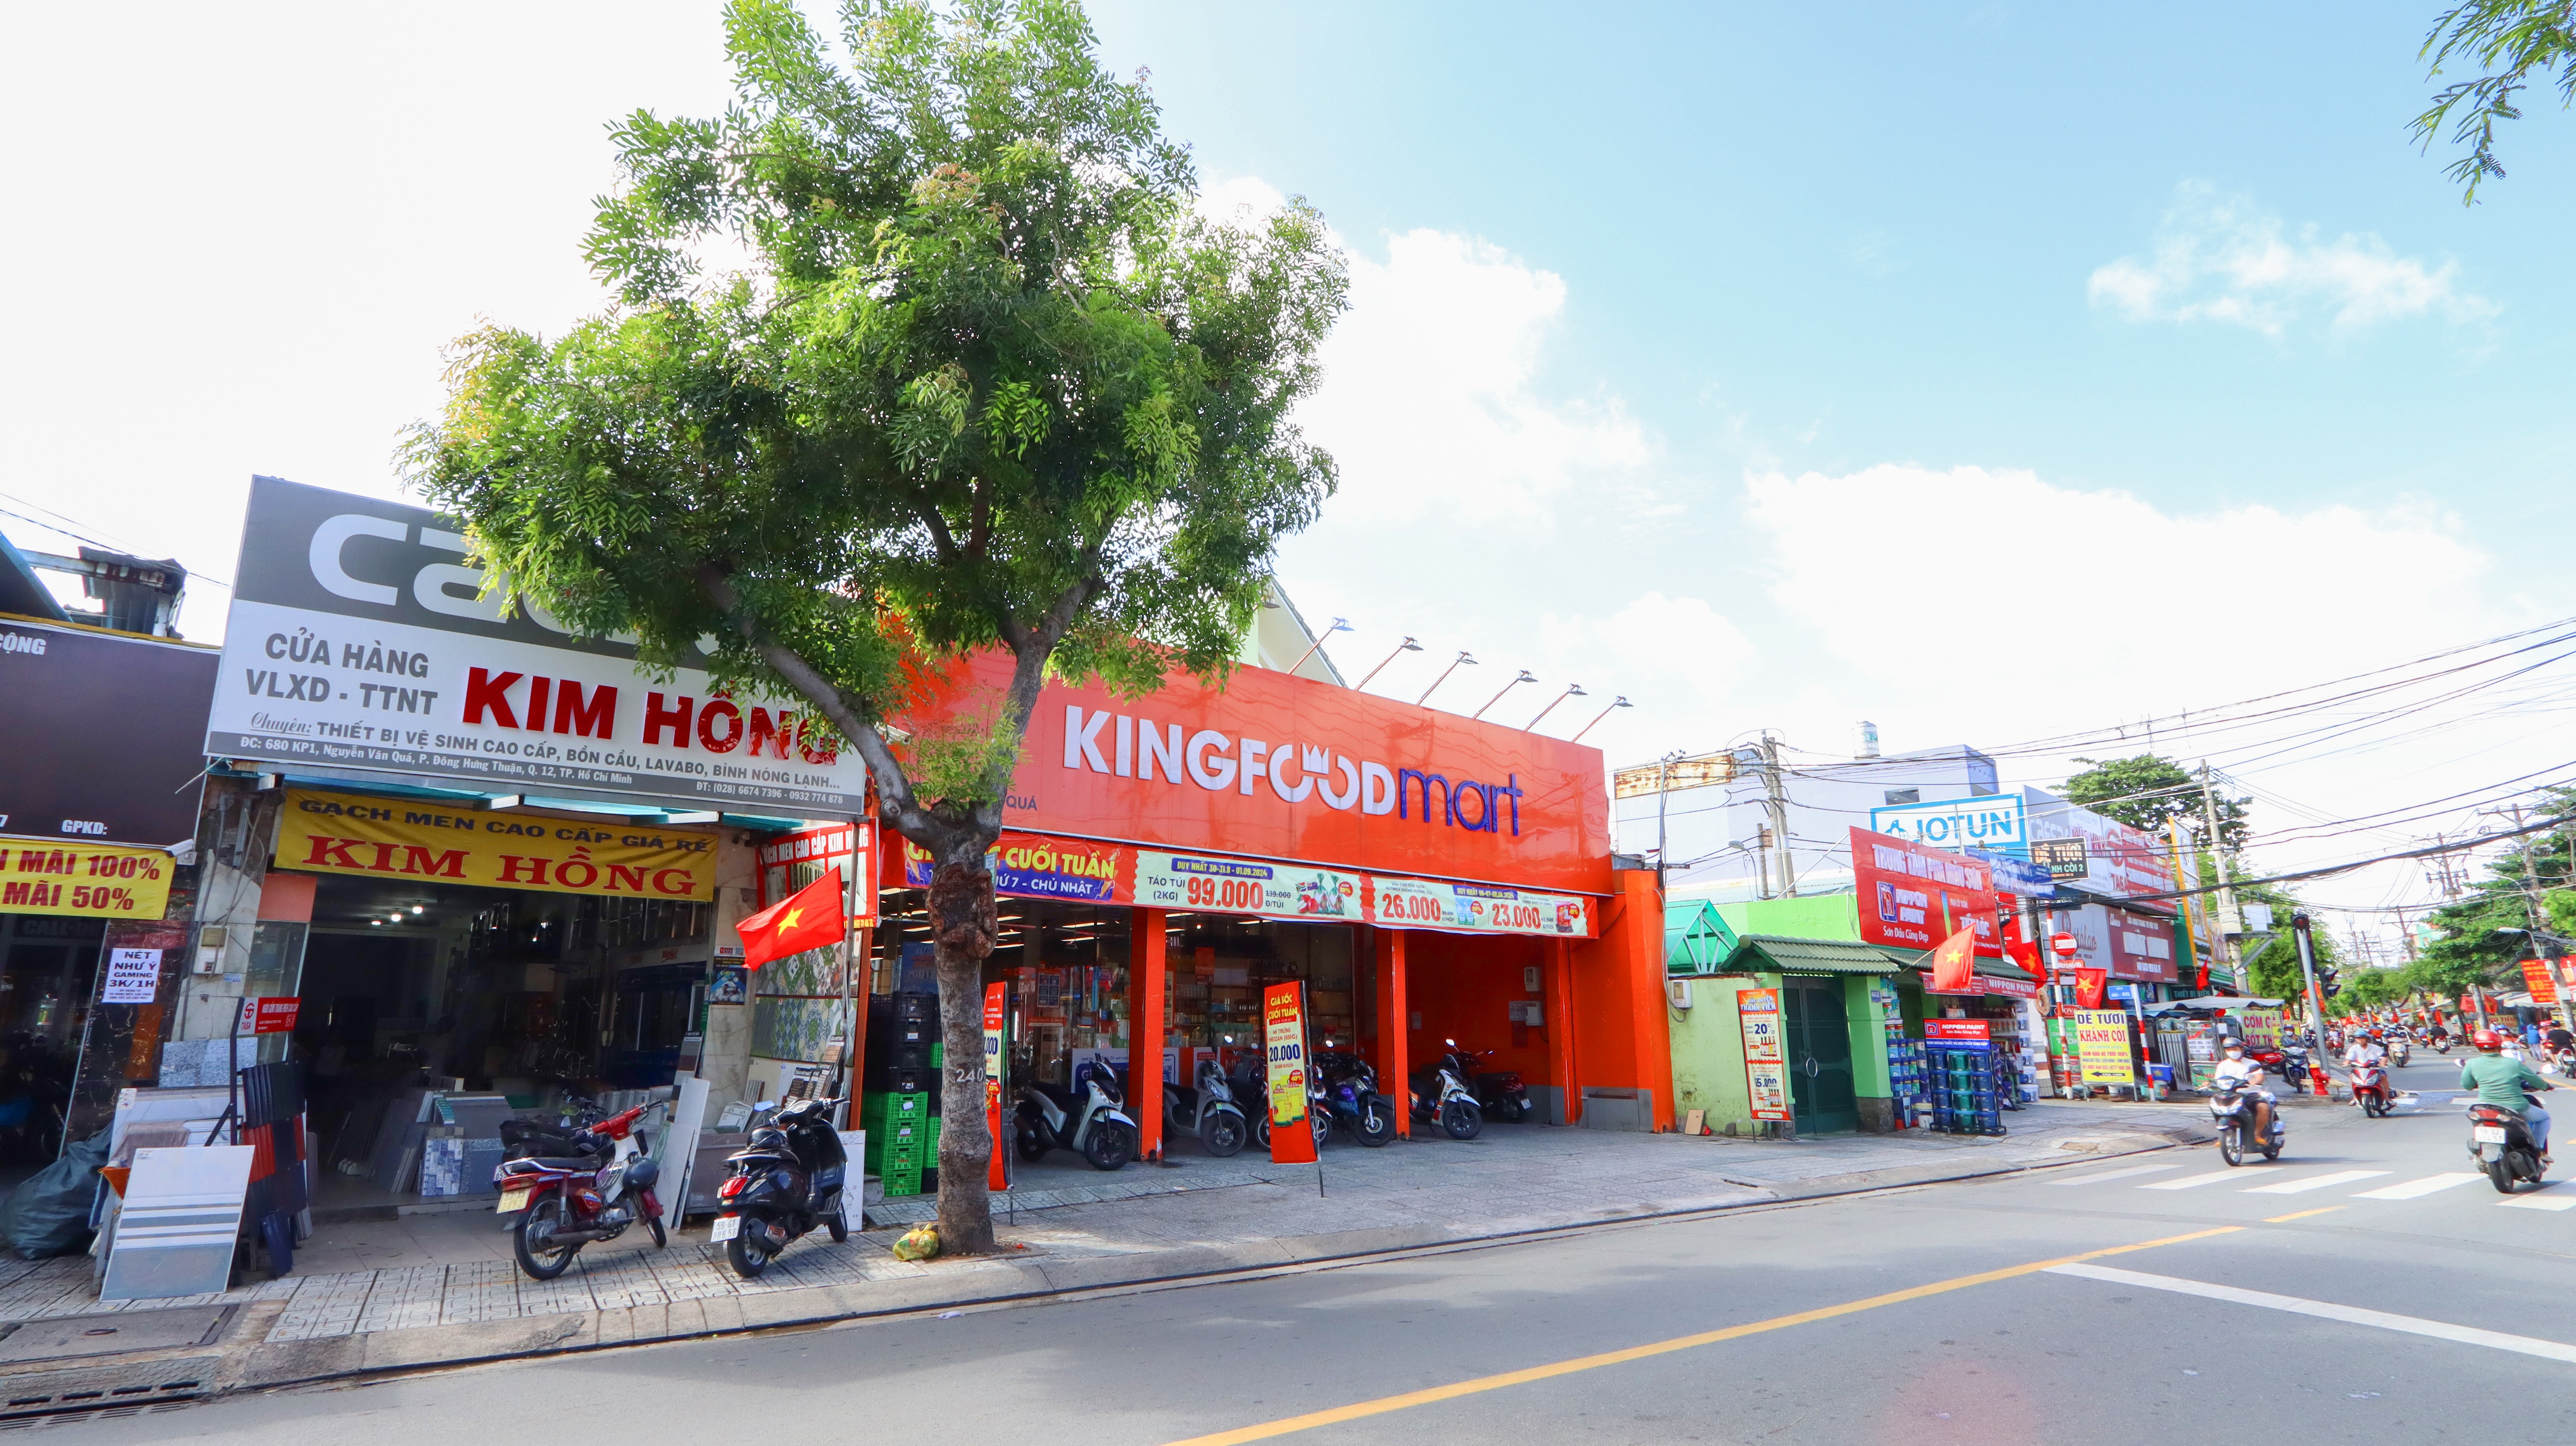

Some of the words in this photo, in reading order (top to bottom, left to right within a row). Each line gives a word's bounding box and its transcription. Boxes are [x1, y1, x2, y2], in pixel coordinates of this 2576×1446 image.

[0, 632, 46, 655] ỘNG
[265, 626, 331, 666] CỬA
[342, 640, 429, 678] HÀNG
[246, 669, 331, 702] VLXD
[360, 683, 438, 714] TTNT
[462, 666, 617, 739] KIM
[251, 711, 312, 734] Chuyên:
[317, 720, 375, 740] THIẾT
[380, 729, 399, 747] BỊ
[406, 730, 428, 749] VỆ
[435, 734, 478, 751] SINH
[483, 739, 518, 755] CAO
[524, 741, 560, 762] CẤP,
[566, 745, 599, 764] BỒN
[605, 749, 640, 770] CẦU,
[646, 757, 708, 778] LAVABO,
[713, 762, 747, 779] BÌNH
[751, 767, 790, 784] NÓNG
[794, 773, 840, 790] LẠNH...
[240, 736, 261, 748] ĐC:
[265, 738, 289, 751] 680
[292, 741, 319, 756] KP1,
[323, 744, 364, 759] Nguyễn
[368, 749, 388, 760] Văn
[392, 752, 415, 765] Quá,
[419, 754, 429, 765] P.
[433, 755, 460, 769] Đông
[463, 756, 489, 772] Hưng
[492, 760, 524, 775] Thuận,
[528, 765, 538, 775] Q.
[542, 766, 556, 778] 12,
[560, 768, 574, 778] TP.
[578, 769, 590, 780] Hồ
[593, 771, 608, 782] Chí
[610, 773, 632, 784] Minh
[696, 781, 711, 791] ĐT:
[714, 783, 735, 795] (028)
[738, 785, 759, 796] 6674
[762, 787, 782, 798] 7396
[789, 790, 809, 802] 0932
[811, 792, 826, 802] 774
[828, 793, 843, 804] 878
[1005, 795, 1038, 811] QUÁ
[61, 820, 107, 835] GPKD:
[299, 799, 391, 821] GẠCH
[404, 811, 475, 831] MEN
[486, 820, 544, 838] CAO
[556, 826, 613, 844] CẤP
[621, 833, 665, 850] GIÁ
[676, 836, 708, 854] RẺ
[1913, 811, 2012, 843] JOTUN
[779, 842, 793, 861] MEN
[795, 839, 810, 858] CAO
[811, 830, 826, 856] CẤP
[828, 832, 844, 853] KIM
[2054, 843, 2082, 863] TƯƠI
[18, 849, 77, 875] MÃI
[88, 855, 160, 880] 100%
[302, 835, 470, 879] KIM
[495, 845, 697, 896] HỒNG
[1005, 844, 1057, 871] CUỐI
[1061, 850, 1115, 879] TUẦN
[1177, 861, 1189, 870] DUY
[1191, 860, 1207, 872] NHẤT
[1236, 867, 1268, 877] 01.09.2024
[1872, 844, 1907, 874] TRUNG
[1964, 867, 1983, 891] SƠN
[2064, 862, 2078, 872] CÒI
[2079, 864, 2084, 872] 2
[1012, 877, 1018, 887] 7
[1031, 876, 1056, 892] CHỦ
[1060, 880, 1093, 896] NHẬT
[1148, 875, 1167, 887] TÁO
[1170, 876, 1185, 887] TÚI
[3, 880, 62, 906] MÃI
[72, 886, 134, 910] 50%
[1153, 891, 1178, 902] (2KG)
[1187, 876, 1263, 909] 99.000
[1266, 890, 1291, 899] 139.000
[1467, 887, 1478, 896] NHẤT
[1265, 899, 1284, 908] Đ/TÚI
[1382, 893, 1441, 921] 26.000
[1492, 903, 1541, 929] 23.000
[1883, 926, 1893, 936] Sơn
[1905, 930, 1918, 942] Cũng
[1919, 931, 1929, 943] Đẹp
[125, 950, 152, 959] NÉT
[114, 962, 145, 970] NHƯ
[148, 961, 157, 970] Ý
[1989, 978, 2017, 990] NIPPON
[2017, 983, 2035, 993] PAINT
[1270, 994, 1281, 1006] GIÁ
[1282, 991, 1293, 1004] SỐC
[1761, 1002, 1777, 1011] VIÊN
[1268, 1006, 1281, 1019] CUỐI
[1281, 1004, 1298, 1017] TUẦN
[2077, 1012, 2093, 1024] DÊ
[2096, 1013, 2125, 1024] TƯƠI
[242, 1022, 251, 1030] TASA
[1754, 1024, 1775, 1034] 20%
[2244, 1015, 2263, 1028] CƠM
[2080, 1027, 2110, 1042] KHÁNH
[2111, 1027, 2126, 1042] CÒI
[2245, 1031, 2260, 1046] SỐT
[1269, 1044, 1300, 1062] 20.000
[956, 1067, 984, 1083] 240
